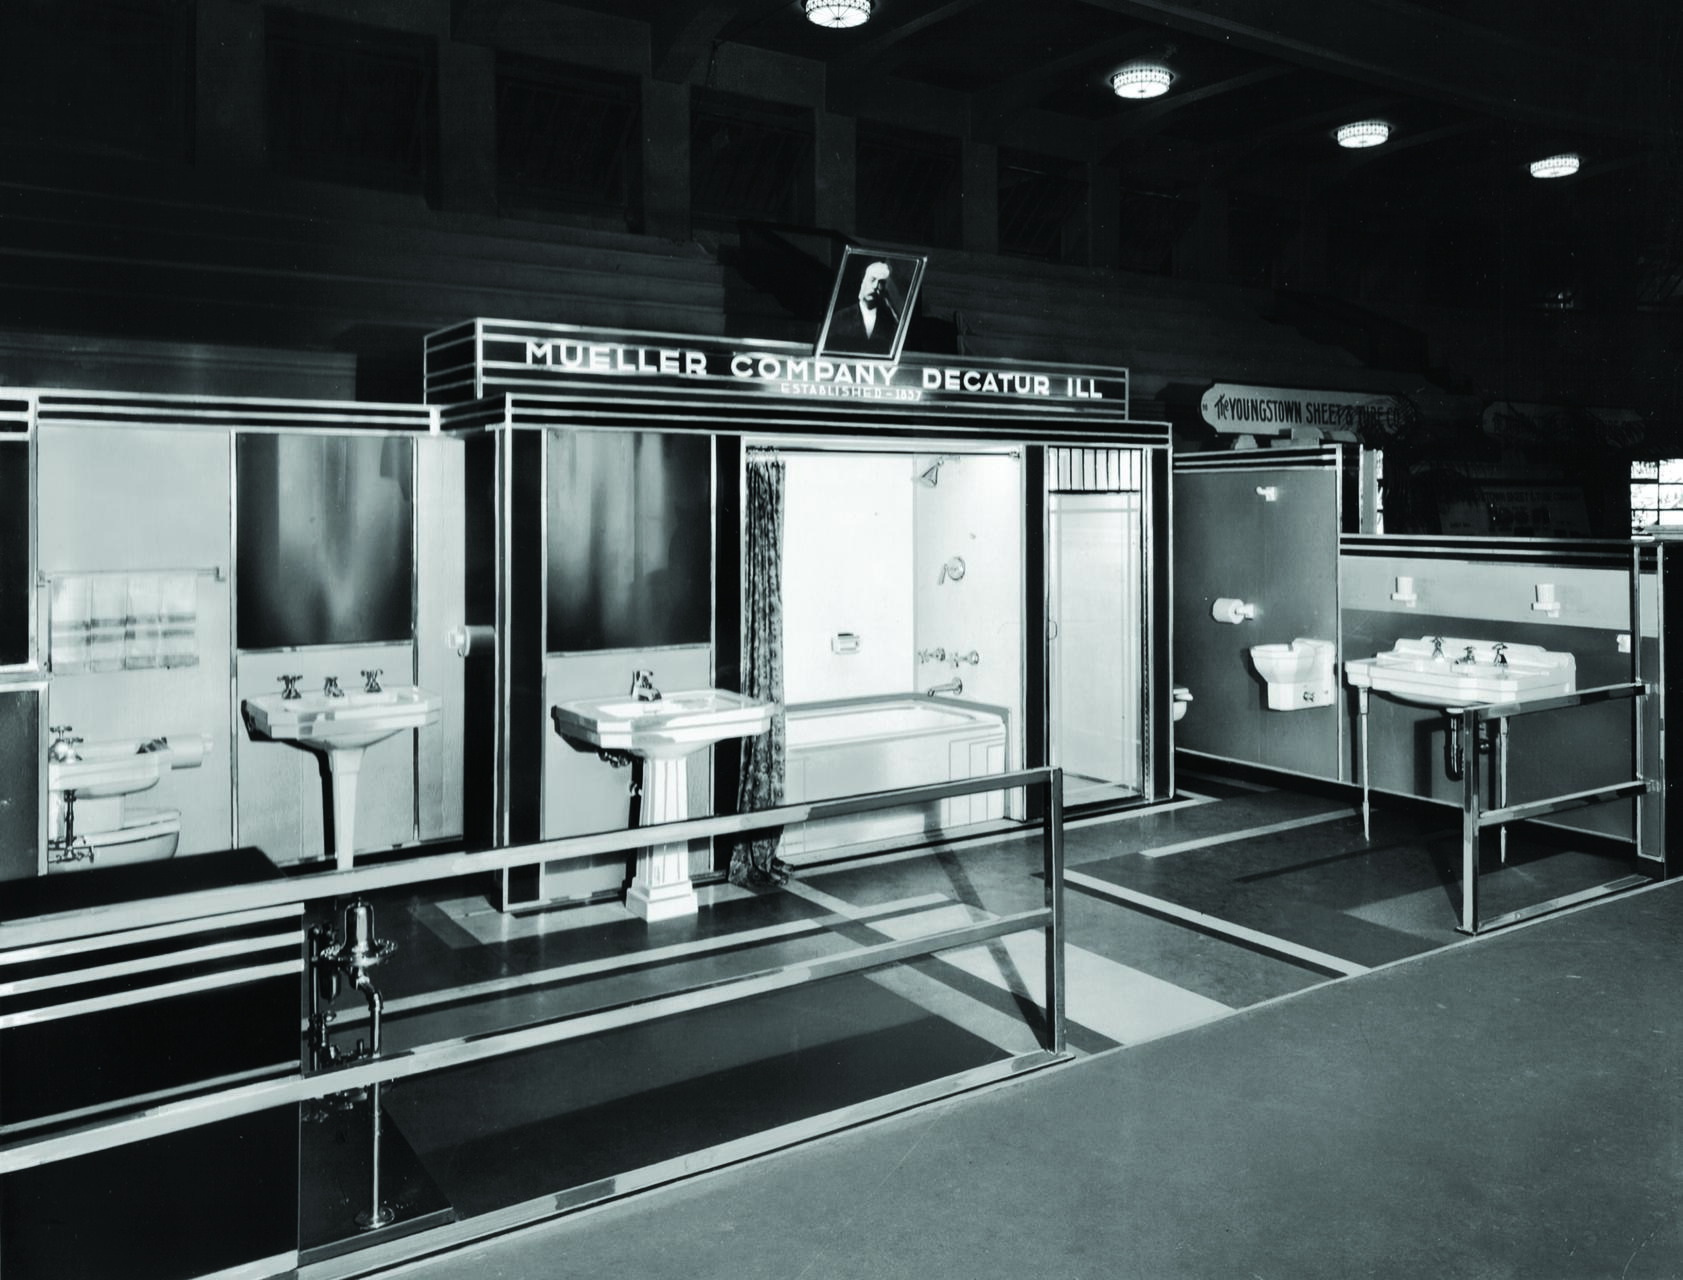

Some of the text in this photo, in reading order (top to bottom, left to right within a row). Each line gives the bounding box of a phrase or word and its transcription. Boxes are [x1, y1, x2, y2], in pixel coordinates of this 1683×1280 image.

[525, 341, 1103, 399] MUELLER COMPANY DECATUR ILL
[780, 382, 882, 399] ESTABLISHED
[1214, 393, 1230, 421] The
[1228, 397, 1303, 424] YOUNGSTOWN
[1305, 402, 1343, 426] SHEET
